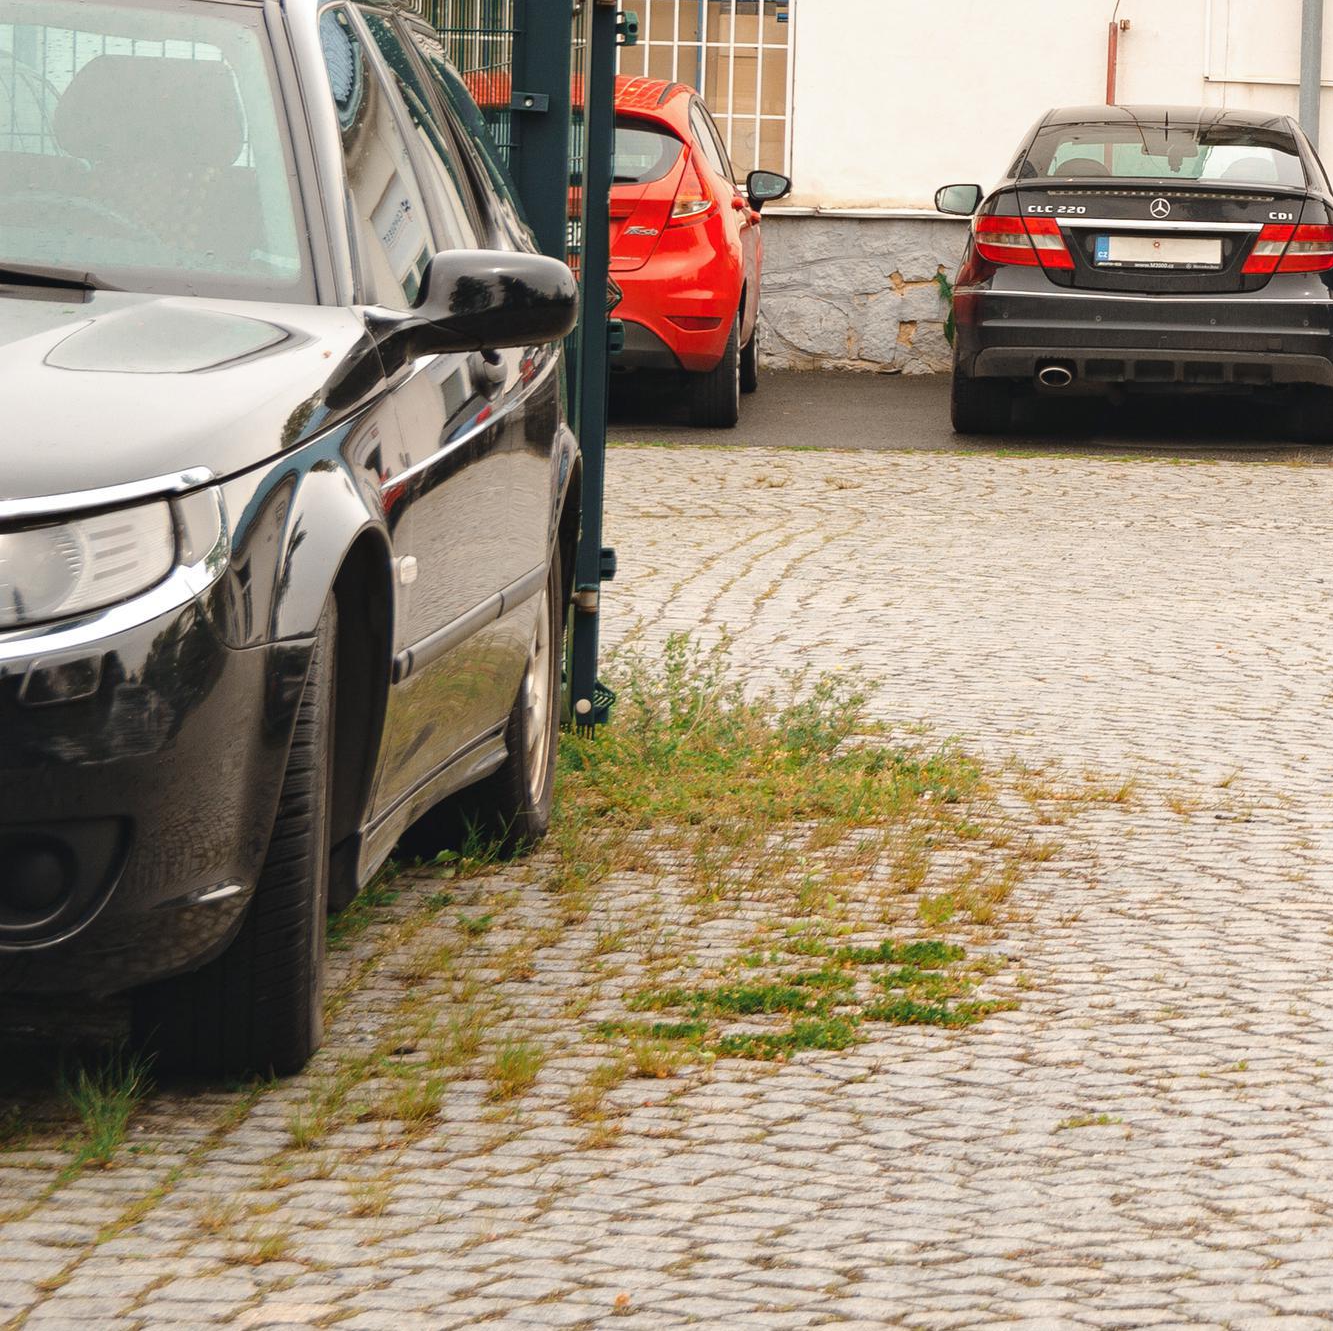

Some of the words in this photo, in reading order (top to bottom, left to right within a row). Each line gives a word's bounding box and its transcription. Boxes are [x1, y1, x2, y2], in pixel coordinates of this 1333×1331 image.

[1028, 205, 1054, 214] CLC
[1057, 205, 1086, 214] 220
[1268, 211, 1293, 220] CDI
